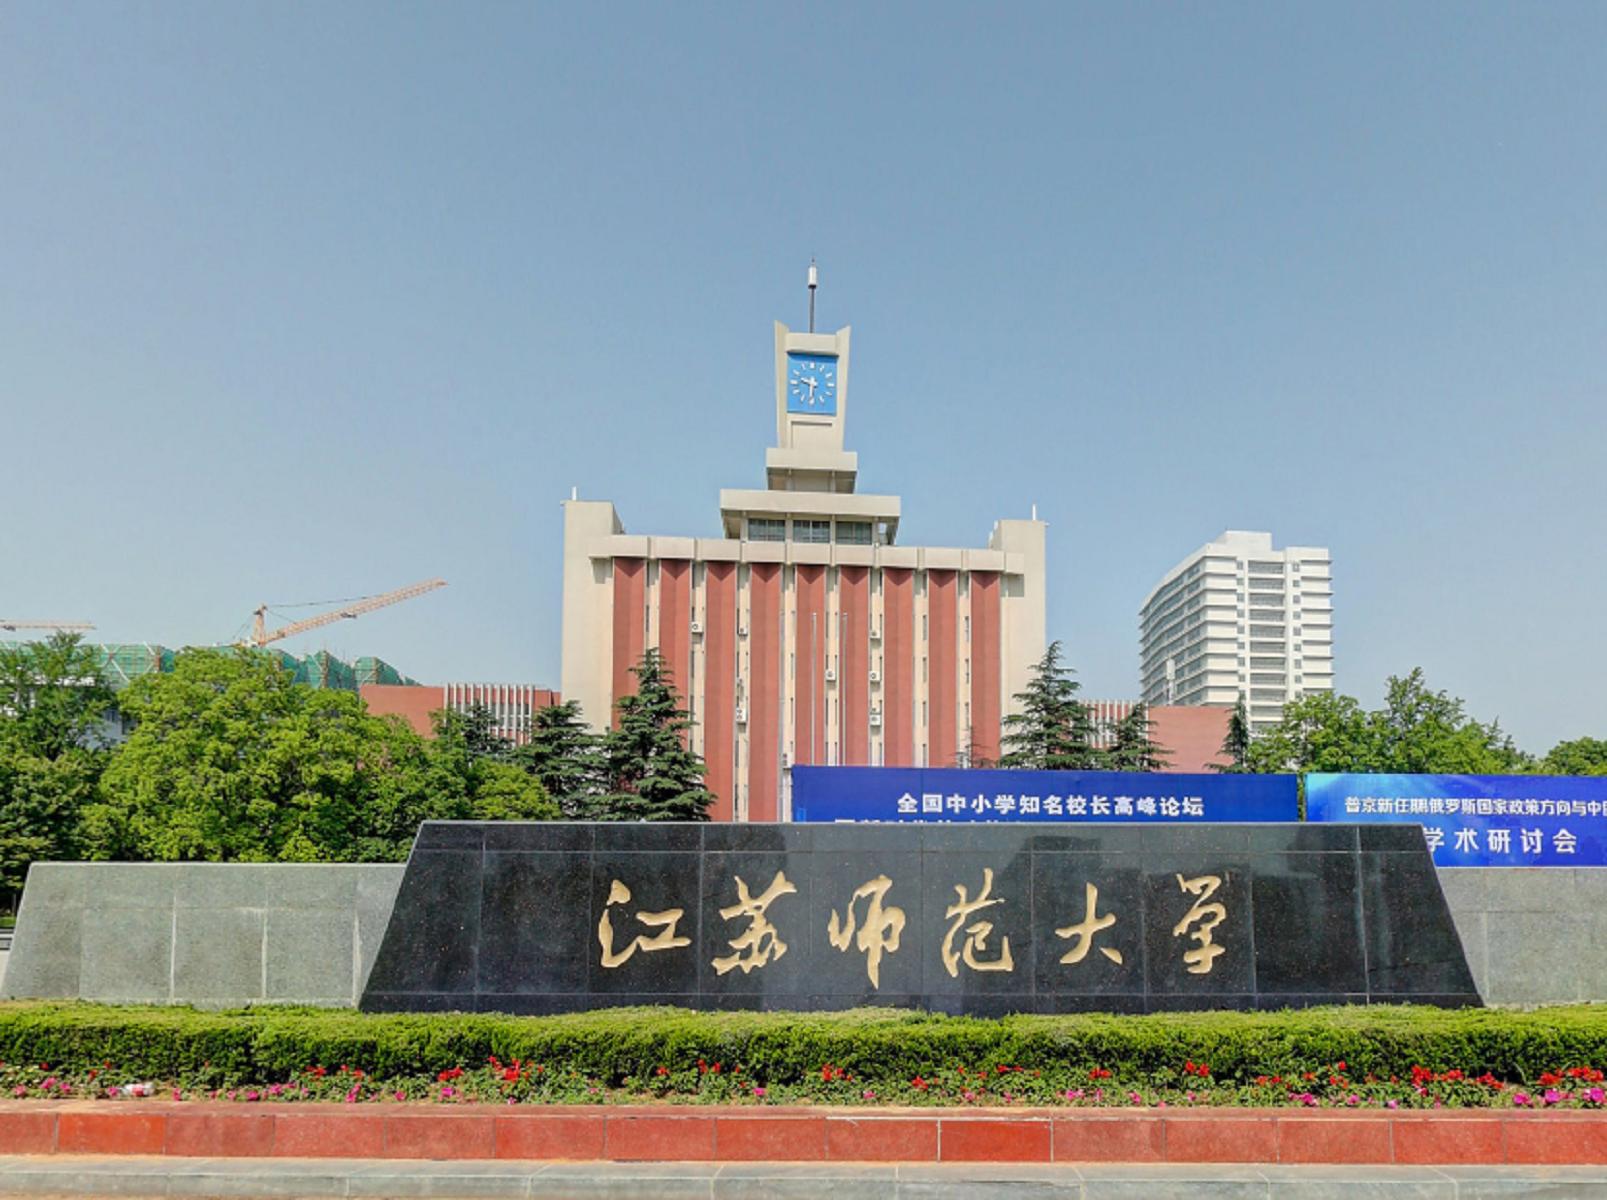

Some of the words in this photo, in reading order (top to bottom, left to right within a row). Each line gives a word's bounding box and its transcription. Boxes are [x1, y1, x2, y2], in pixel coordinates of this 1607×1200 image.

[897, 792, 1204, 817] 全国中小学知名校长高峰论坛
[1423, 827, 1577, 853] 学术研讨会
